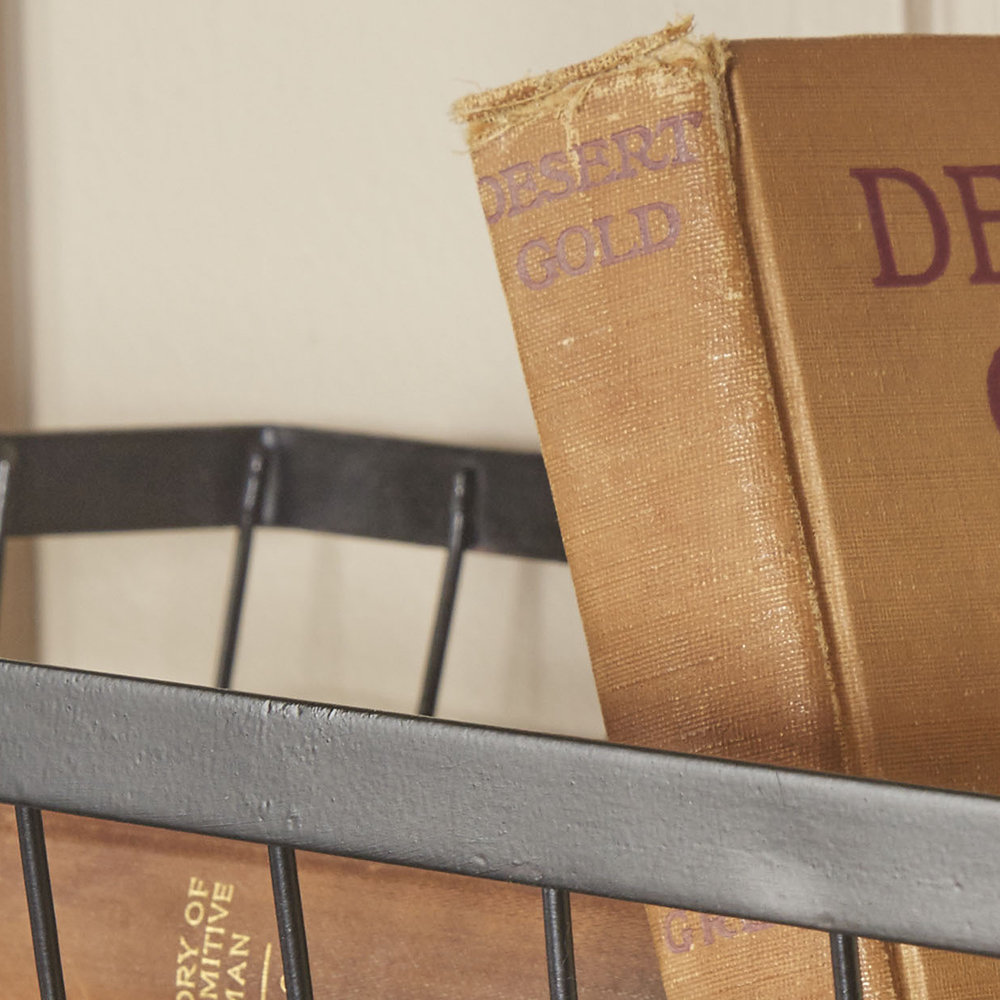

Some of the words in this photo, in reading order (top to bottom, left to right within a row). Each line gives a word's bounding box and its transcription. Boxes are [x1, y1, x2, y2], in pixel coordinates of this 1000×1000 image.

[477, 110, 704, 225] DESERT
[514, 201, 683, 291] GOLD
[850, 164, 1000, 288] DE
[184, 876, 210, 927] OF
